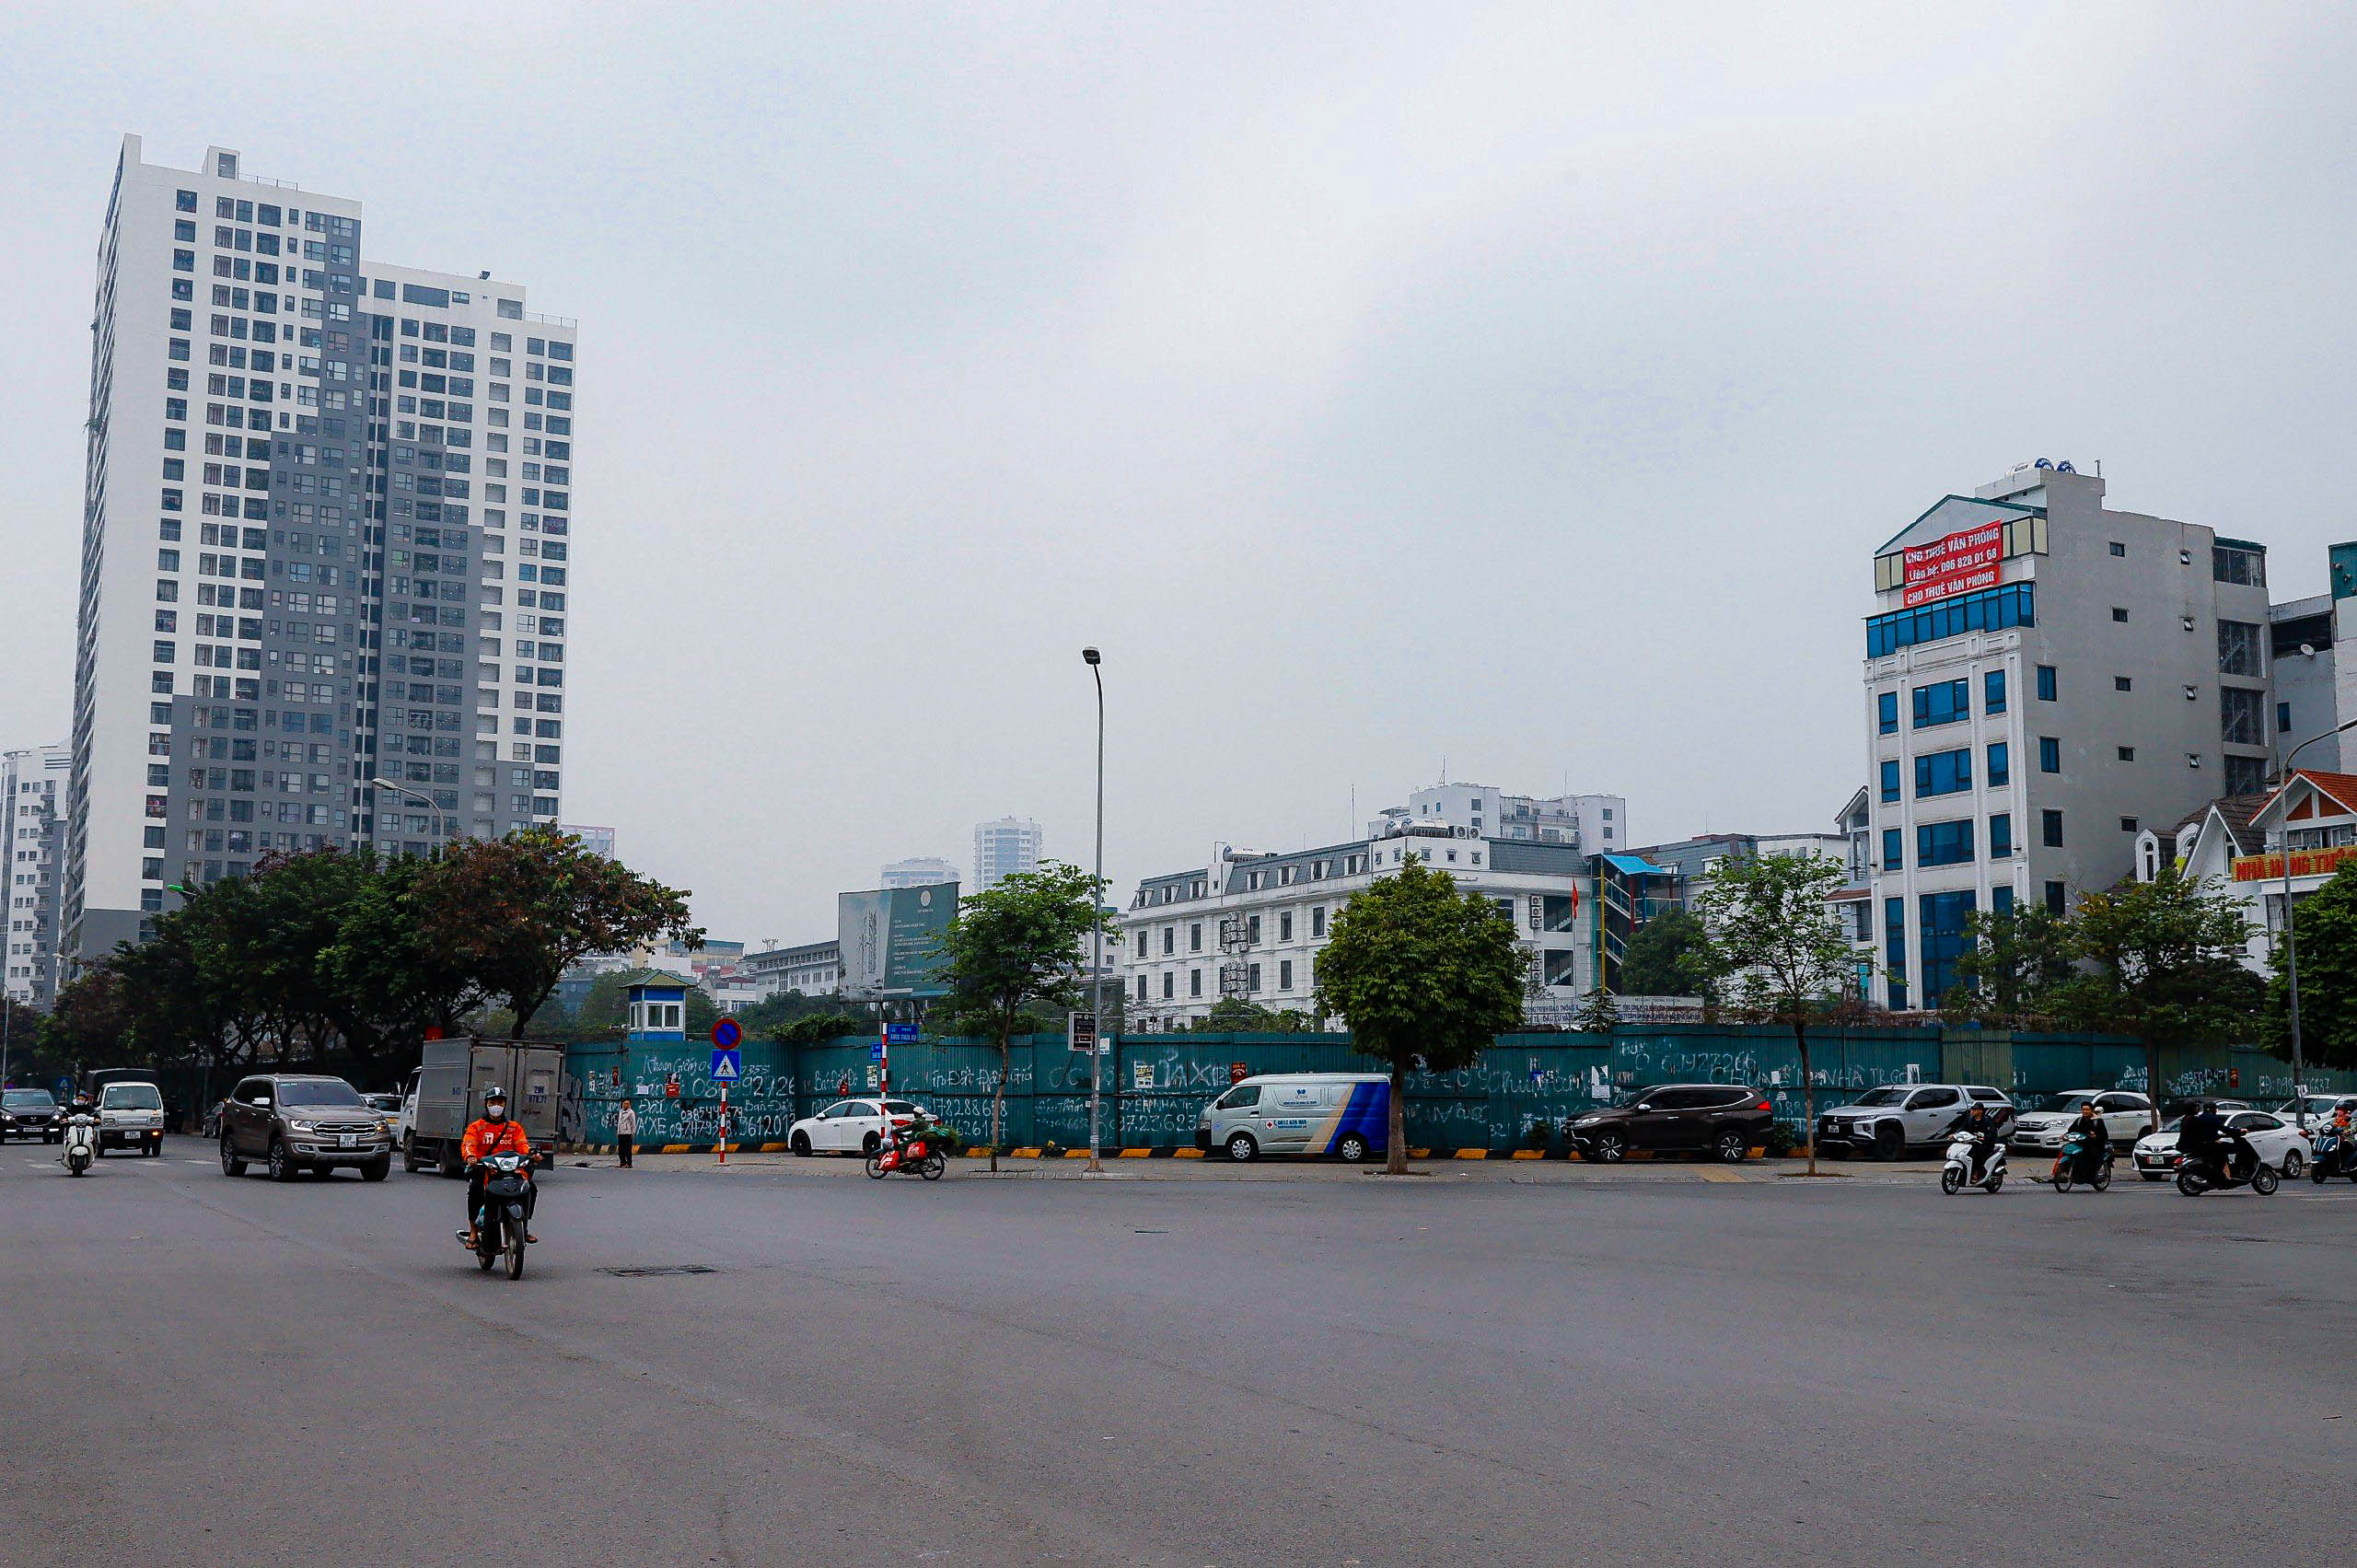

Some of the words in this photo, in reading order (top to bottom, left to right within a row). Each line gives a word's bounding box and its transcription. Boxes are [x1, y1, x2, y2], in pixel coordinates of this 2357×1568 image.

[1905, 551, 1923, 564] CHO
[1947, 536, 1967, 552] VĂN
[1968, 527, 2000, 548] PHÒNG
[1941, 561, 1956, 573] 096
[1956, 554, 1973, 568] 828
[1974, 552, 1984, 563] 01
[1986, 547, 1997, 560] 68
[1907, 590, 1923, 604] CHO
[1947, 576, 1965, 593] VĂN
[1967, 570, 1995, 587] PHÒNG
